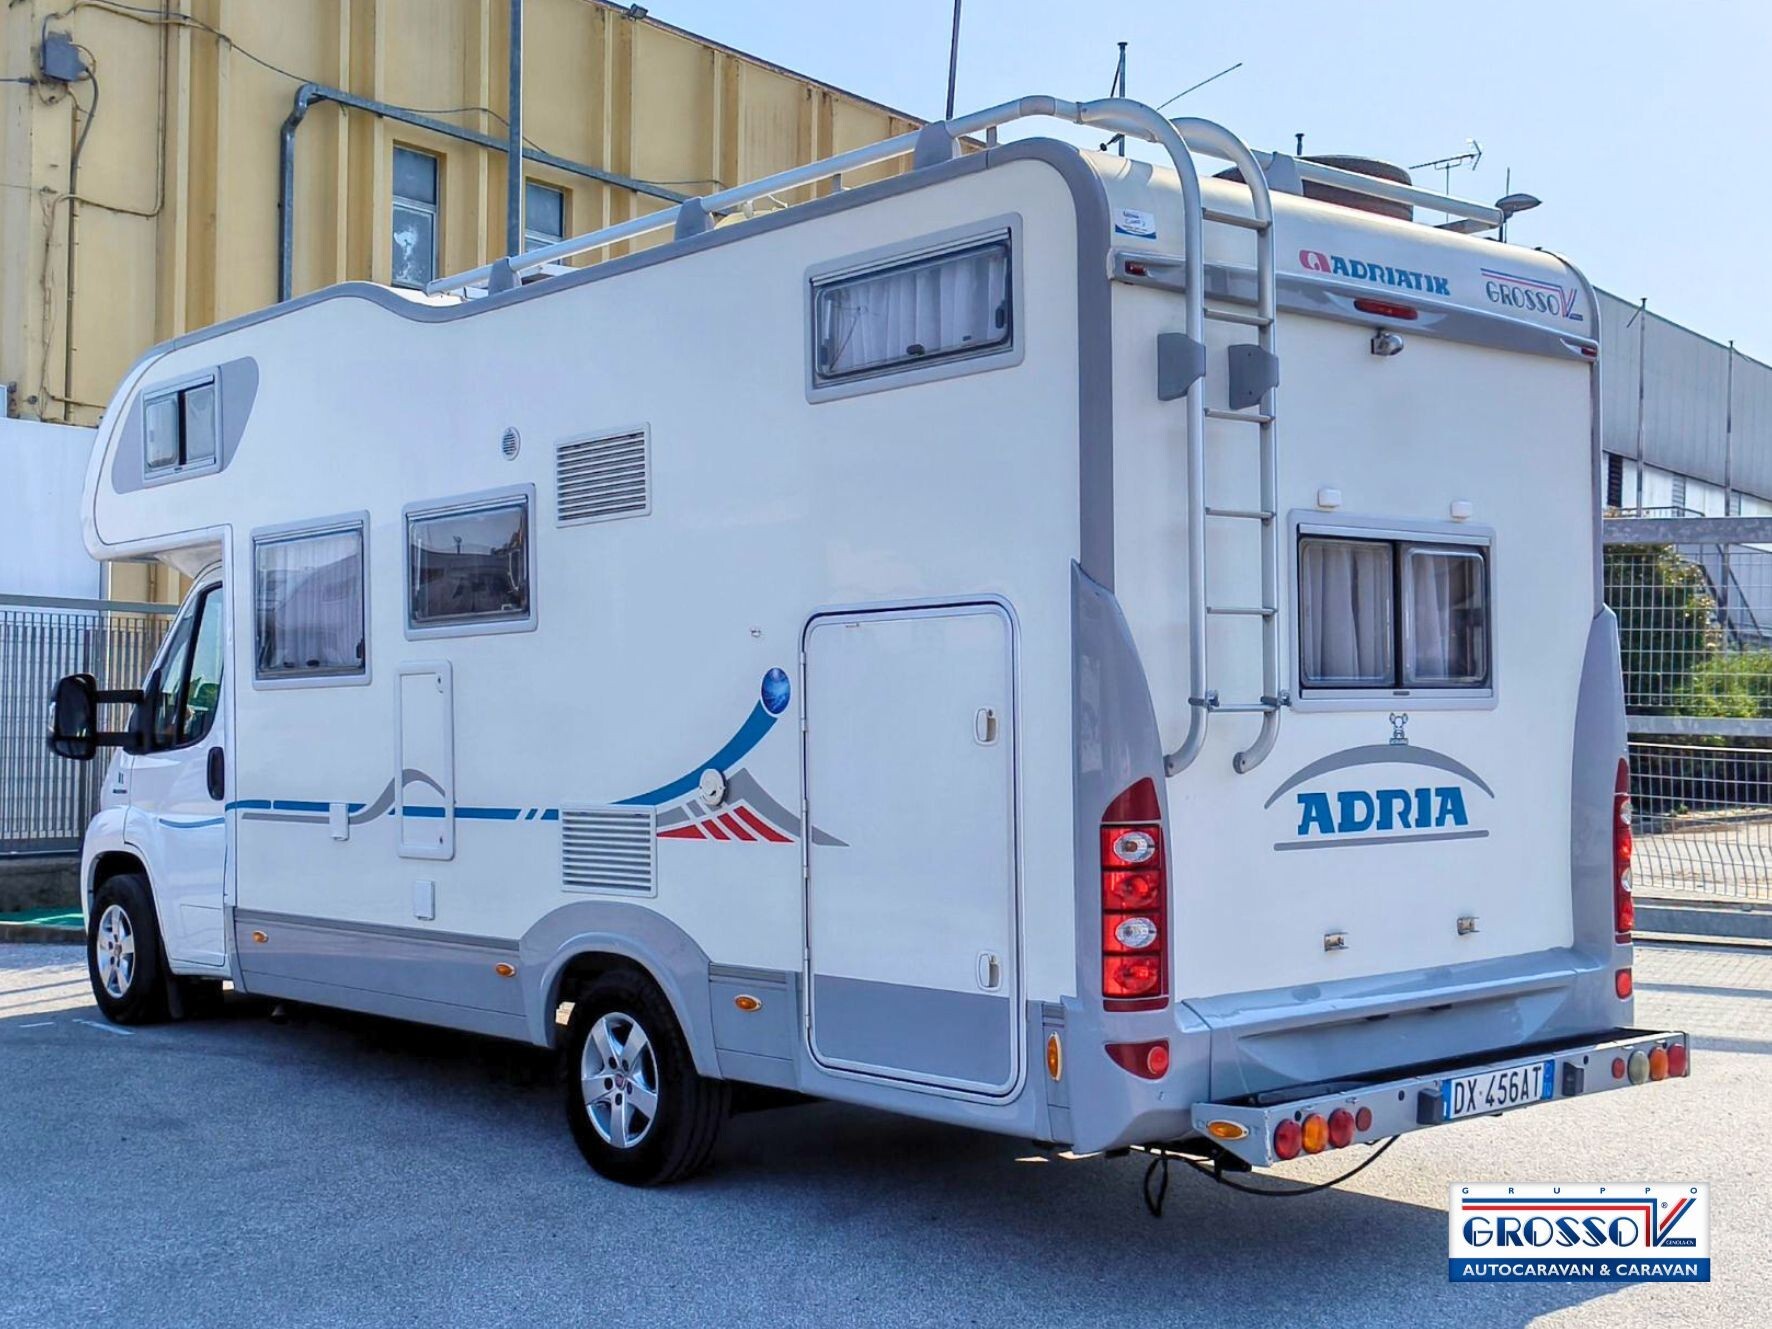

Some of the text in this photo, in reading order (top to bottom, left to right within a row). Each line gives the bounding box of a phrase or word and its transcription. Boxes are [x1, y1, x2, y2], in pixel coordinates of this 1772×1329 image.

[1331, 255, 1451, 296] ADRIATIK
[1486, 280, 1560, 316] GROSSO
[1297, 786, 1469, 836] ADRIA
